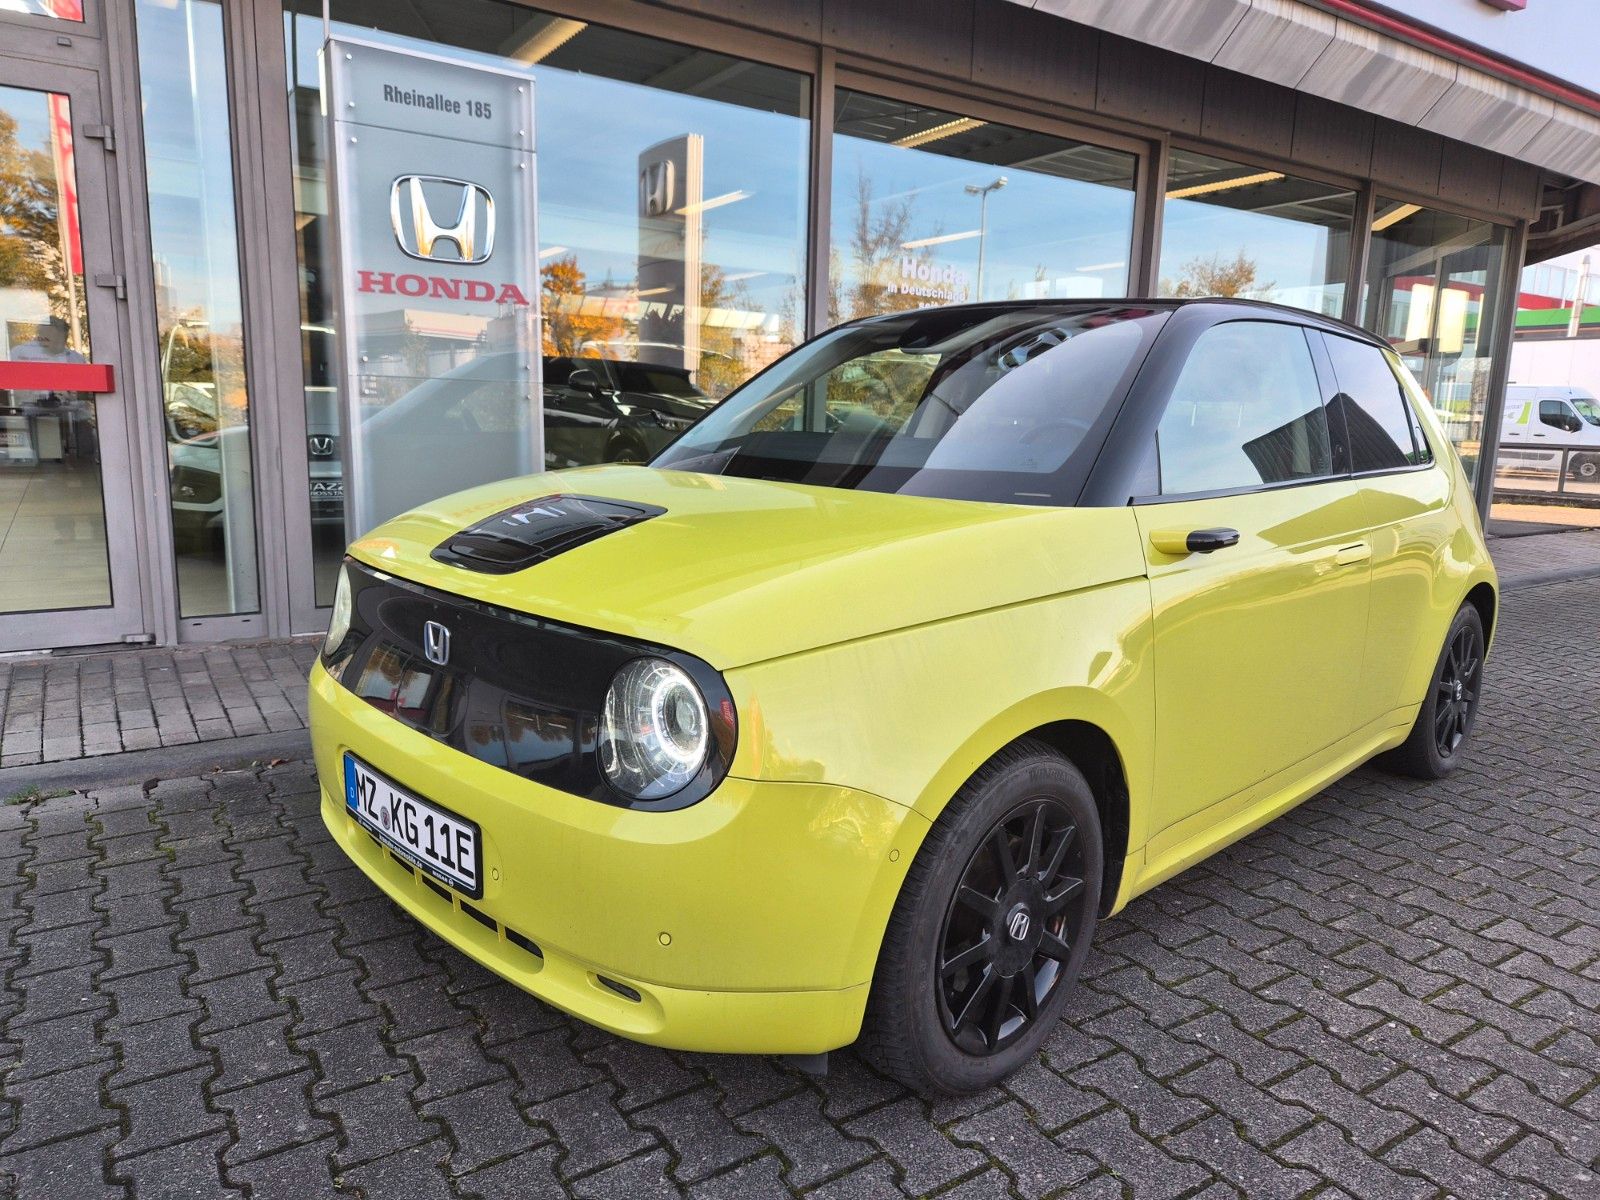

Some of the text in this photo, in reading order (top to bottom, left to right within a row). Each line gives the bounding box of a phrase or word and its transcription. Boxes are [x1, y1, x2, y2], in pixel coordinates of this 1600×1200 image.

[383, 84, 492, 120] Rheinallee 185
[357, 270, 529, 305] HONDA
[901, 283, 966, 301] Deutschland
